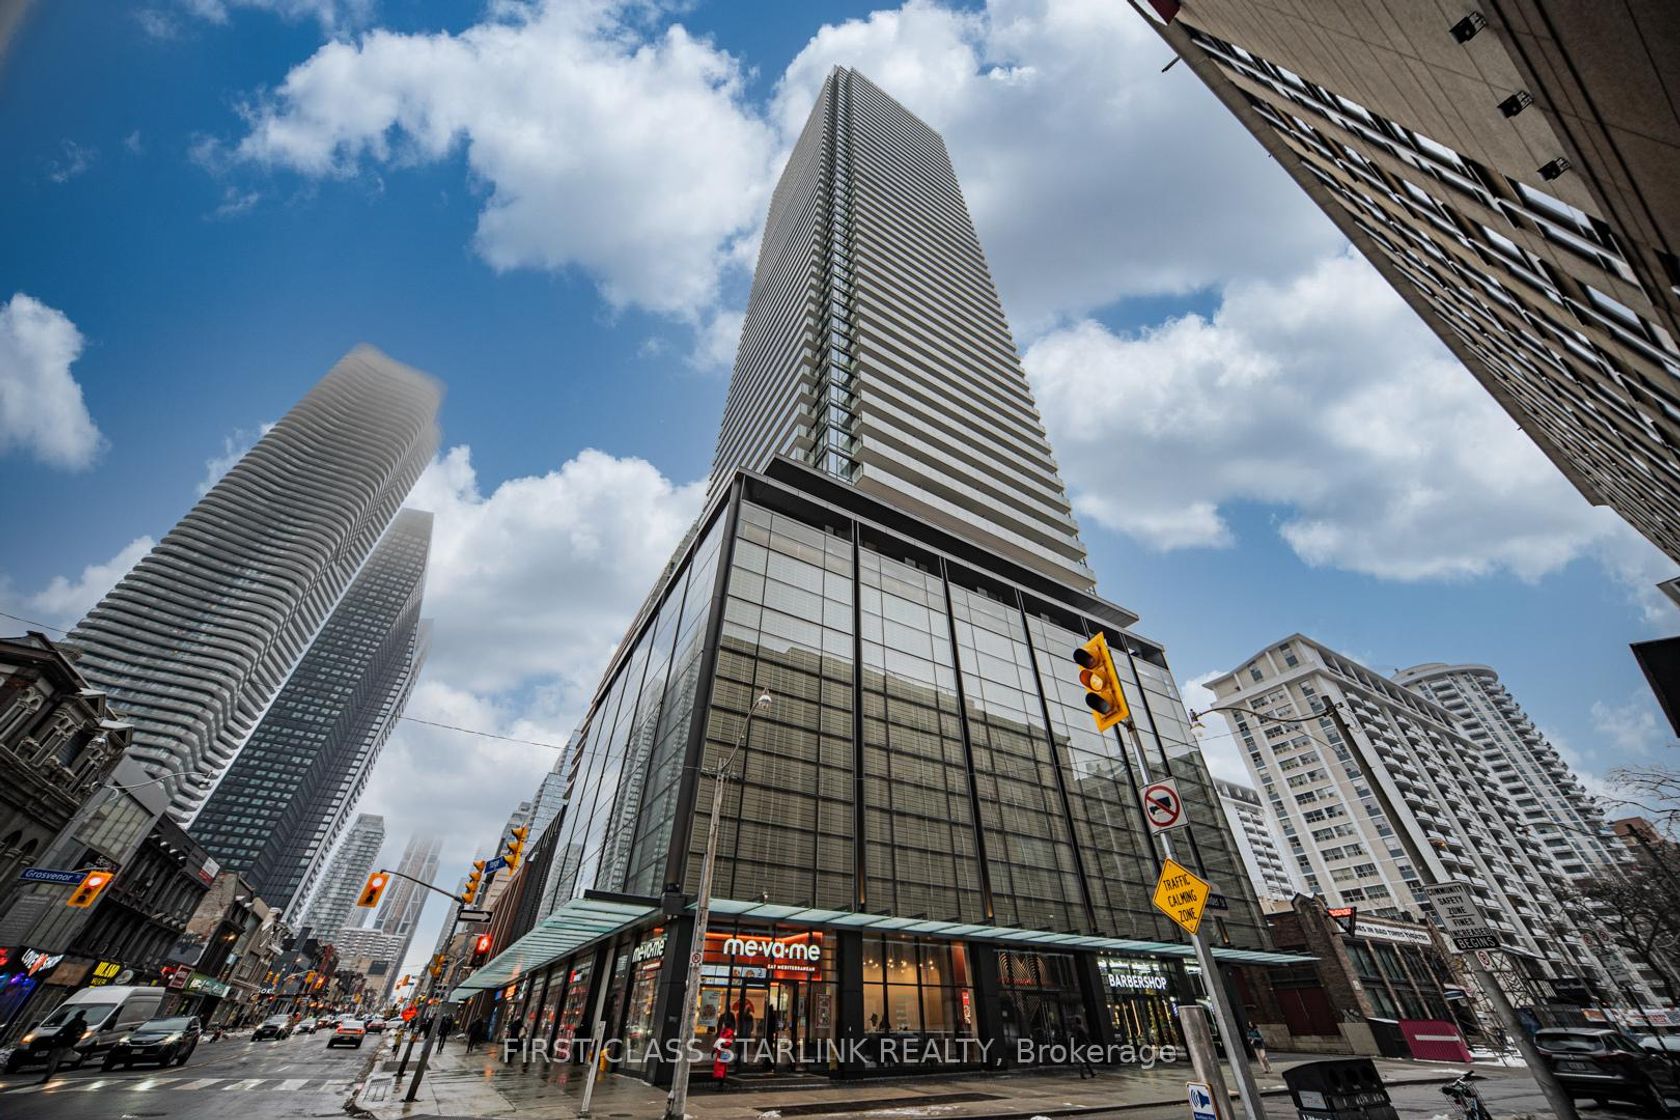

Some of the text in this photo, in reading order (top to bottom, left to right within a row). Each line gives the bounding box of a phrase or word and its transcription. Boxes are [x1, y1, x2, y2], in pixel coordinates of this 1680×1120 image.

[25, 869, 73, 881] Grosvenor
[1163, 874, 1190, 891] TRAFFIC
[1168, 889, 1197, 907] CALMING
[1437, 896, 1463, 905] SAFETY
[1178, 908, 1197, 922] ZONE
[1447, 906, 1467, 914] ZONE
[1453, 918, 1475, 926] FINES
[1457, 936, 1495, 949] BEGINS
[1108, 974, 1167, 990] BARBERSHOP
